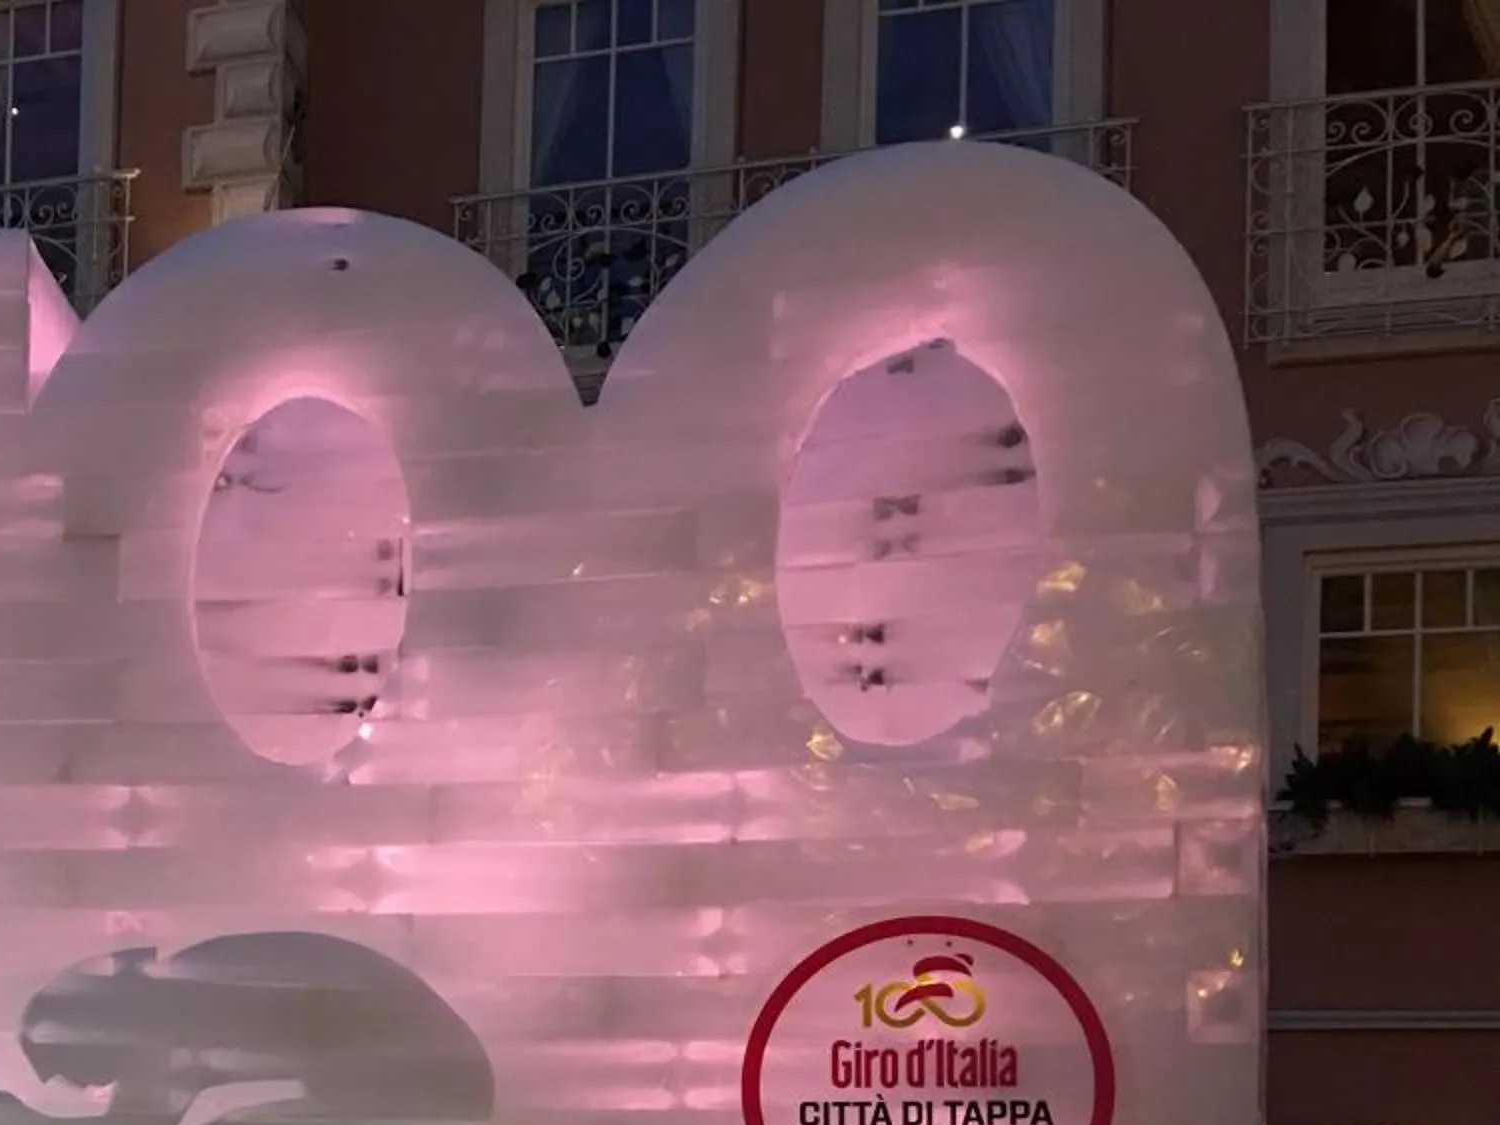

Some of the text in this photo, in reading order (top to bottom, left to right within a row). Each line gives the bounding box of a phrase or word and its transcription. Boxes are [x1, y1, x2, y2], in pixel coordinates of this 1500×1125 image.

[854, 980, 987, 1028] 100
[831, 1037, 1018, 1089] Giro d'Italia
